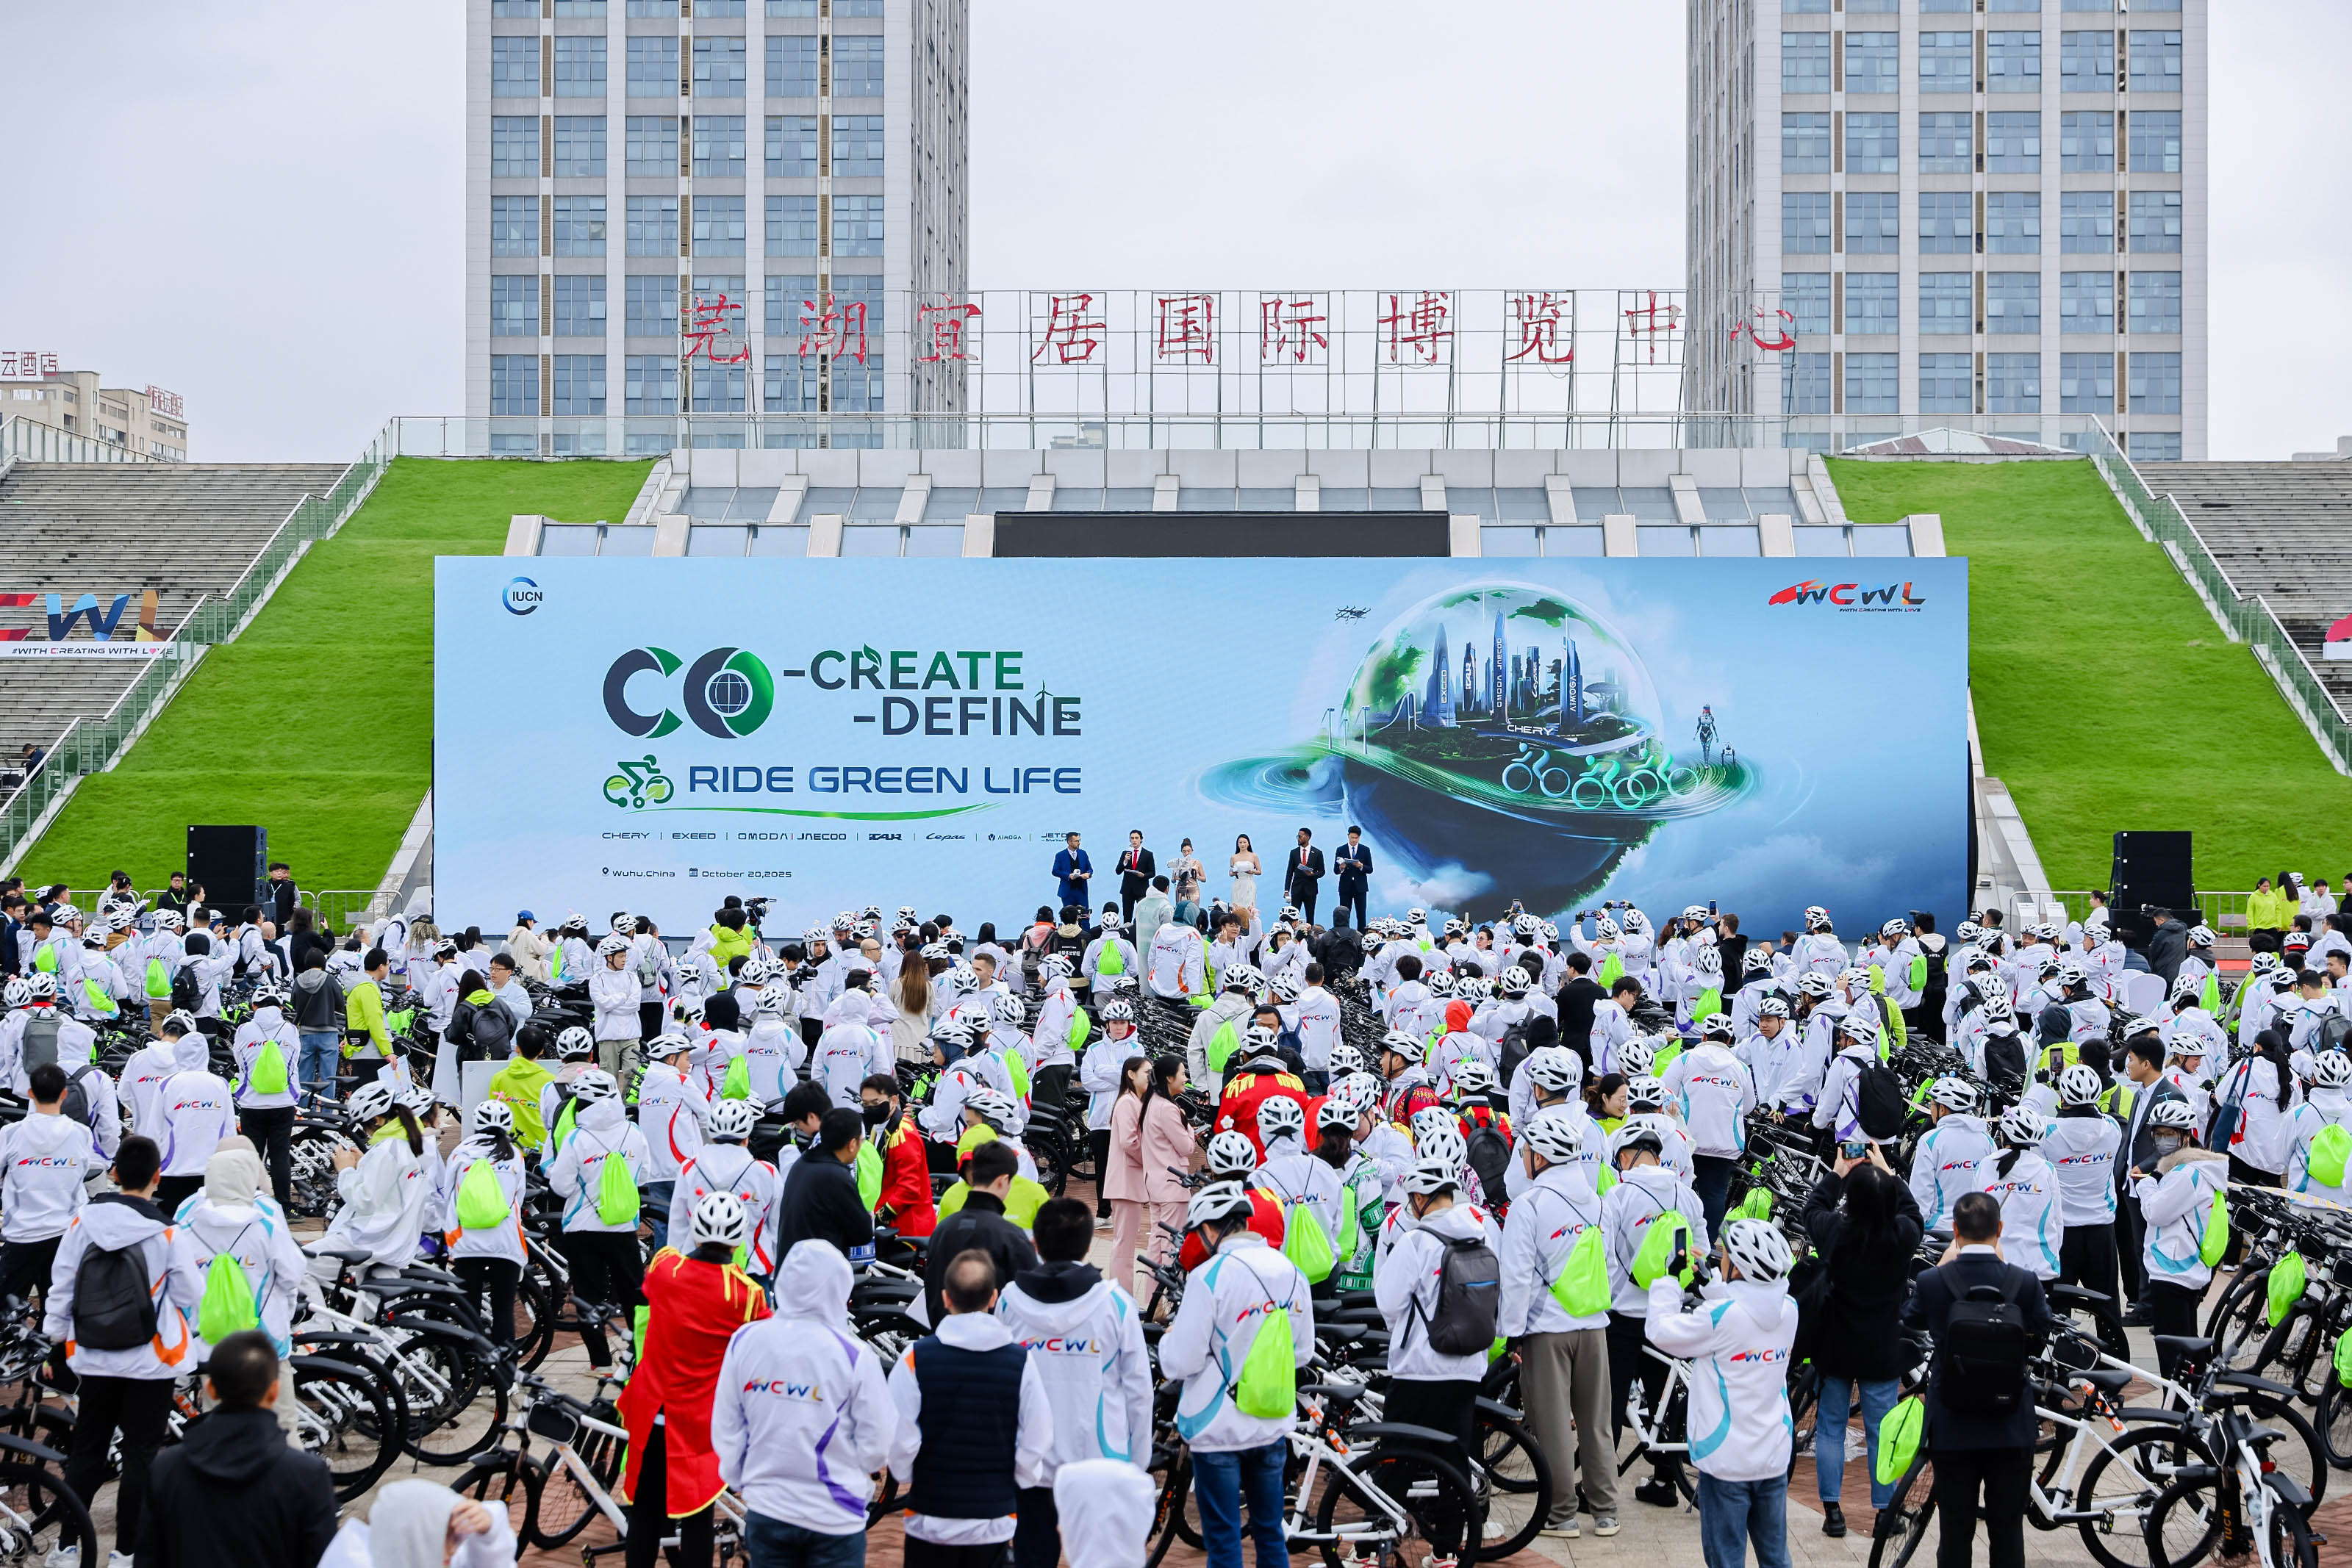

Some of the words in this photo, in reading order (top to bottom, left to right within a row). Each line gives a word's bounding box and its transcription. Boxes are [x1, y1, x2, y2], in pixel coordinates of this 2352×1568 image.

[681, 290, 1796, 365] 芜湖宜居国际博览中心
[1, 351, 58, 376] 云酒店
[512, 591, 543, 601] IUCN
[1507, 724, 1554, 736] CHERY
[689, 766, 795, 794] RIDE
[808, 766, 969, 794] GREEN
[984, 766, 1082, 794] LIFE
[601, 832, 650, 840] CHERY
[702, 870, 745, 878] October
[747, 871, 792, 879] 20,2025
[1699, 1076, 1740, 1088] WCWL
[179, 1101, 222, 1109] WCWL
[509, 1098, 538, 1107] WCW
[29, 1158, 77, 1166] WCWL
[2068, 1151, 2113, 1165] WCWL
[1993, 1182, 2043, 1193] WCWL
[1025, 1337, 1100, 1353] WCWL
[751, 1380, 824, 1402] WCWL
